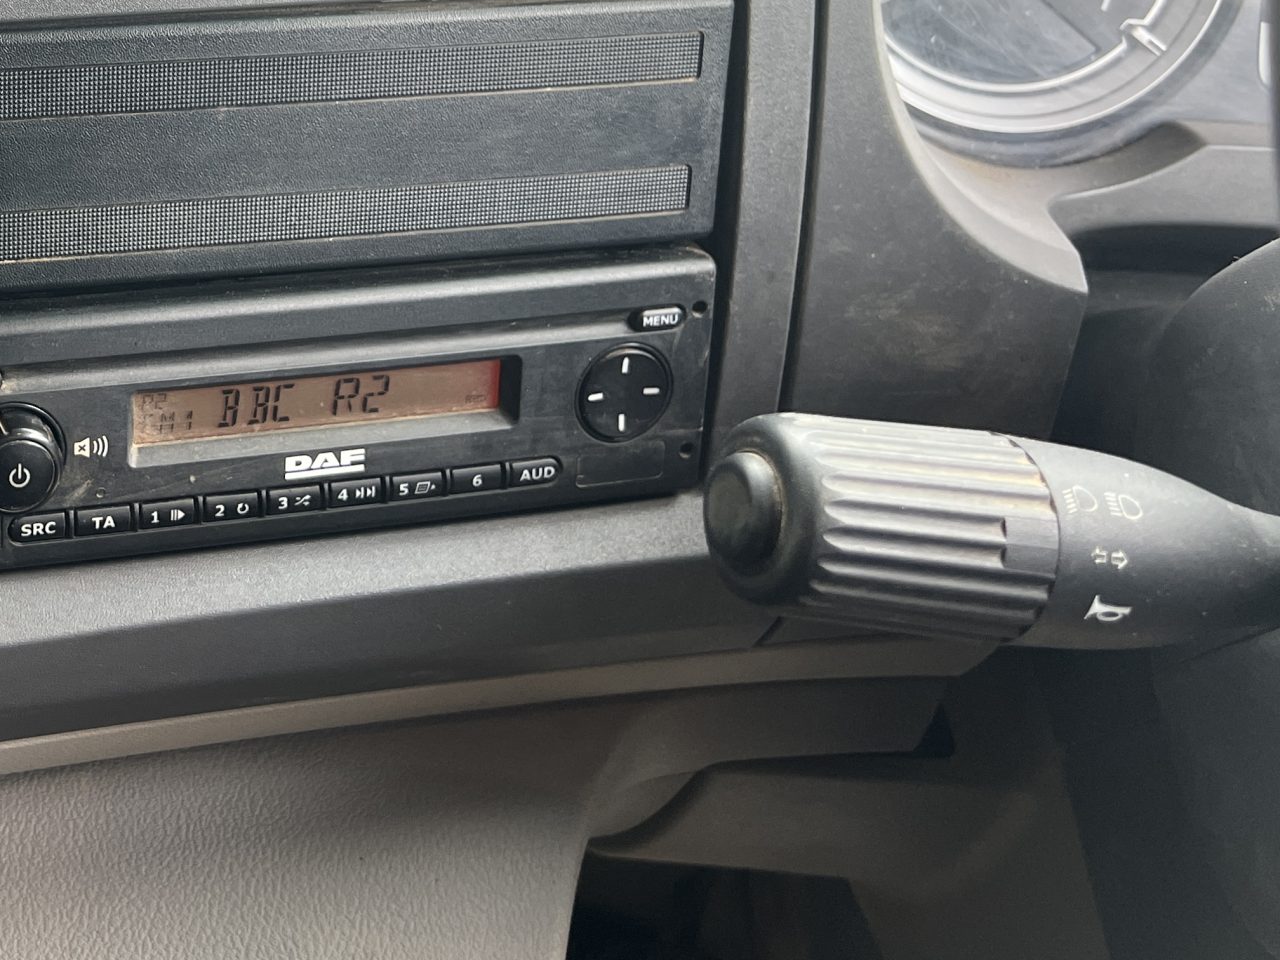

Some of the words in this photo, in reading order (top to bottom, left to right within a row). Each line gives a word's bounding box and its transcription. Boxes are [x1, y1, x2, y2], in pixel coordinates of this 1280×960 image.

[642, 313, 679, 327] MENU
[217, 383, 296, 429] BBC
[332, 374, 391, 416] R2
[284, 448, 365, 473] DAF
[472, 474, 483, 487] 6
[520, 466, 556, 482] AUD
[337, 491, 349, 502] 4
[399, 484, 409, 496] 5
[278, 497, 288, 510] 3
[150, 511, 160, 524] 1
[214, 505, 225, 517] 2
[20, 521, 57, 538] SRC
[91, 516, 116, 530] TA
